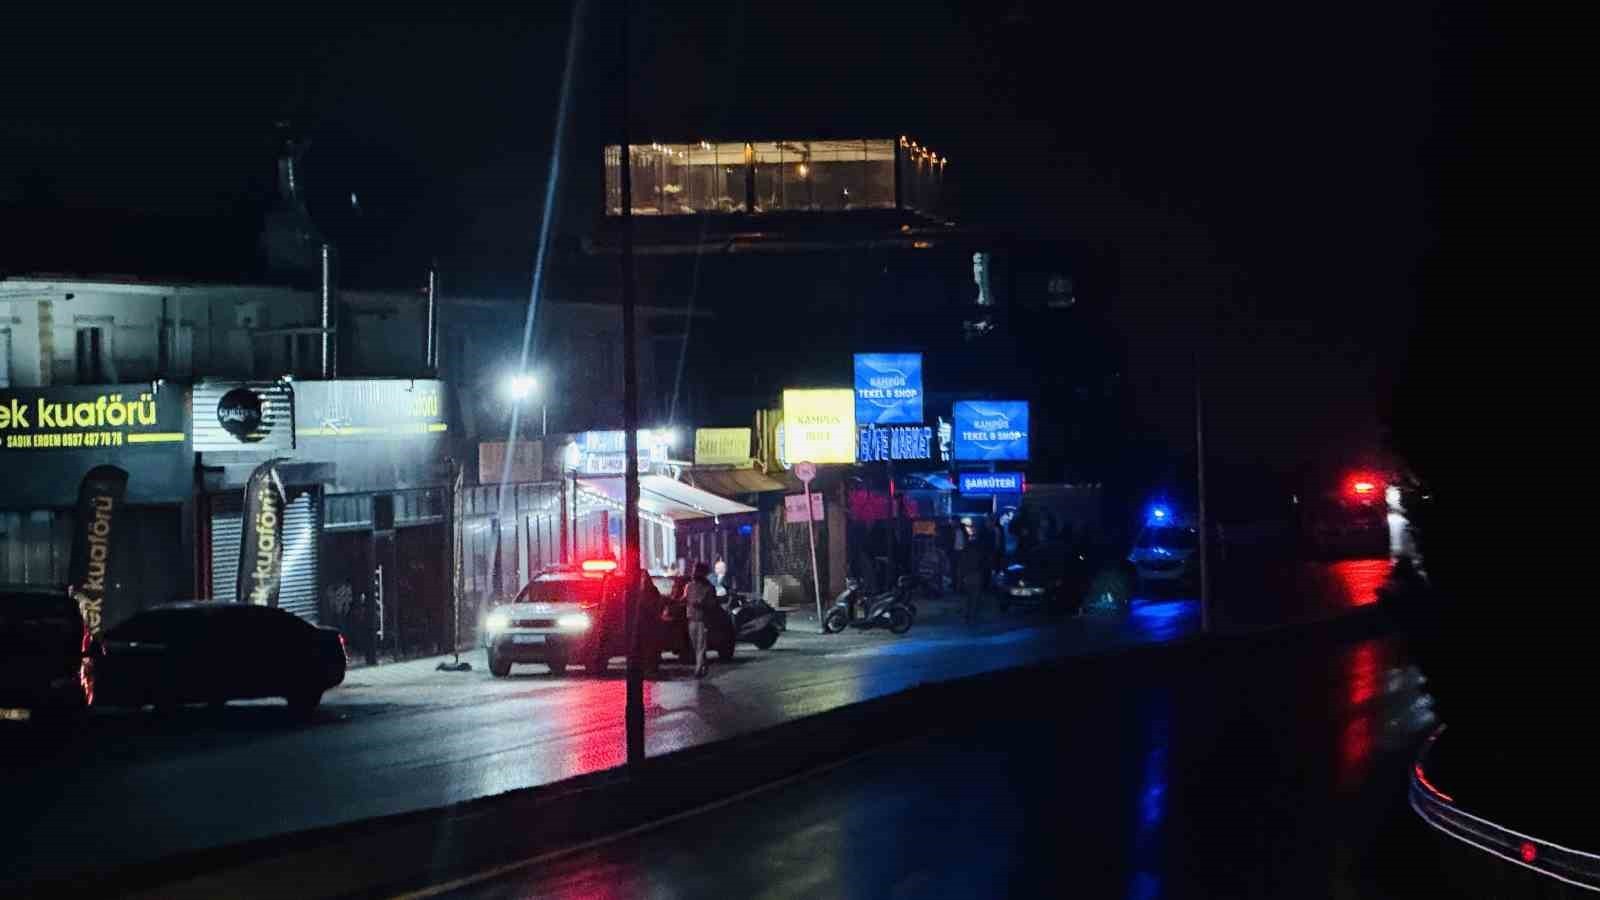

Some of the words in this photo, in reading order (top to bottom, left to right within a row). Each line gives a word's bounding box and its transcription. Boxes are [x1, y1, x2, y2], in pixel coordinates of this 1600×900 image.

[858, 388, 884, 399] TEKEL
[894, 388, 918, 399] SHOP
[38, 393, 157, 428] kuaförü
[33, 433, 61, 447] ERDEM
[963, 431, 989, 441] TEKEL
[997, 431, 1022, 441] SHOP
[965, 476, 1016, 491] ŞARKÜTERİ
[82, 495, 113, 591] kuaförü
